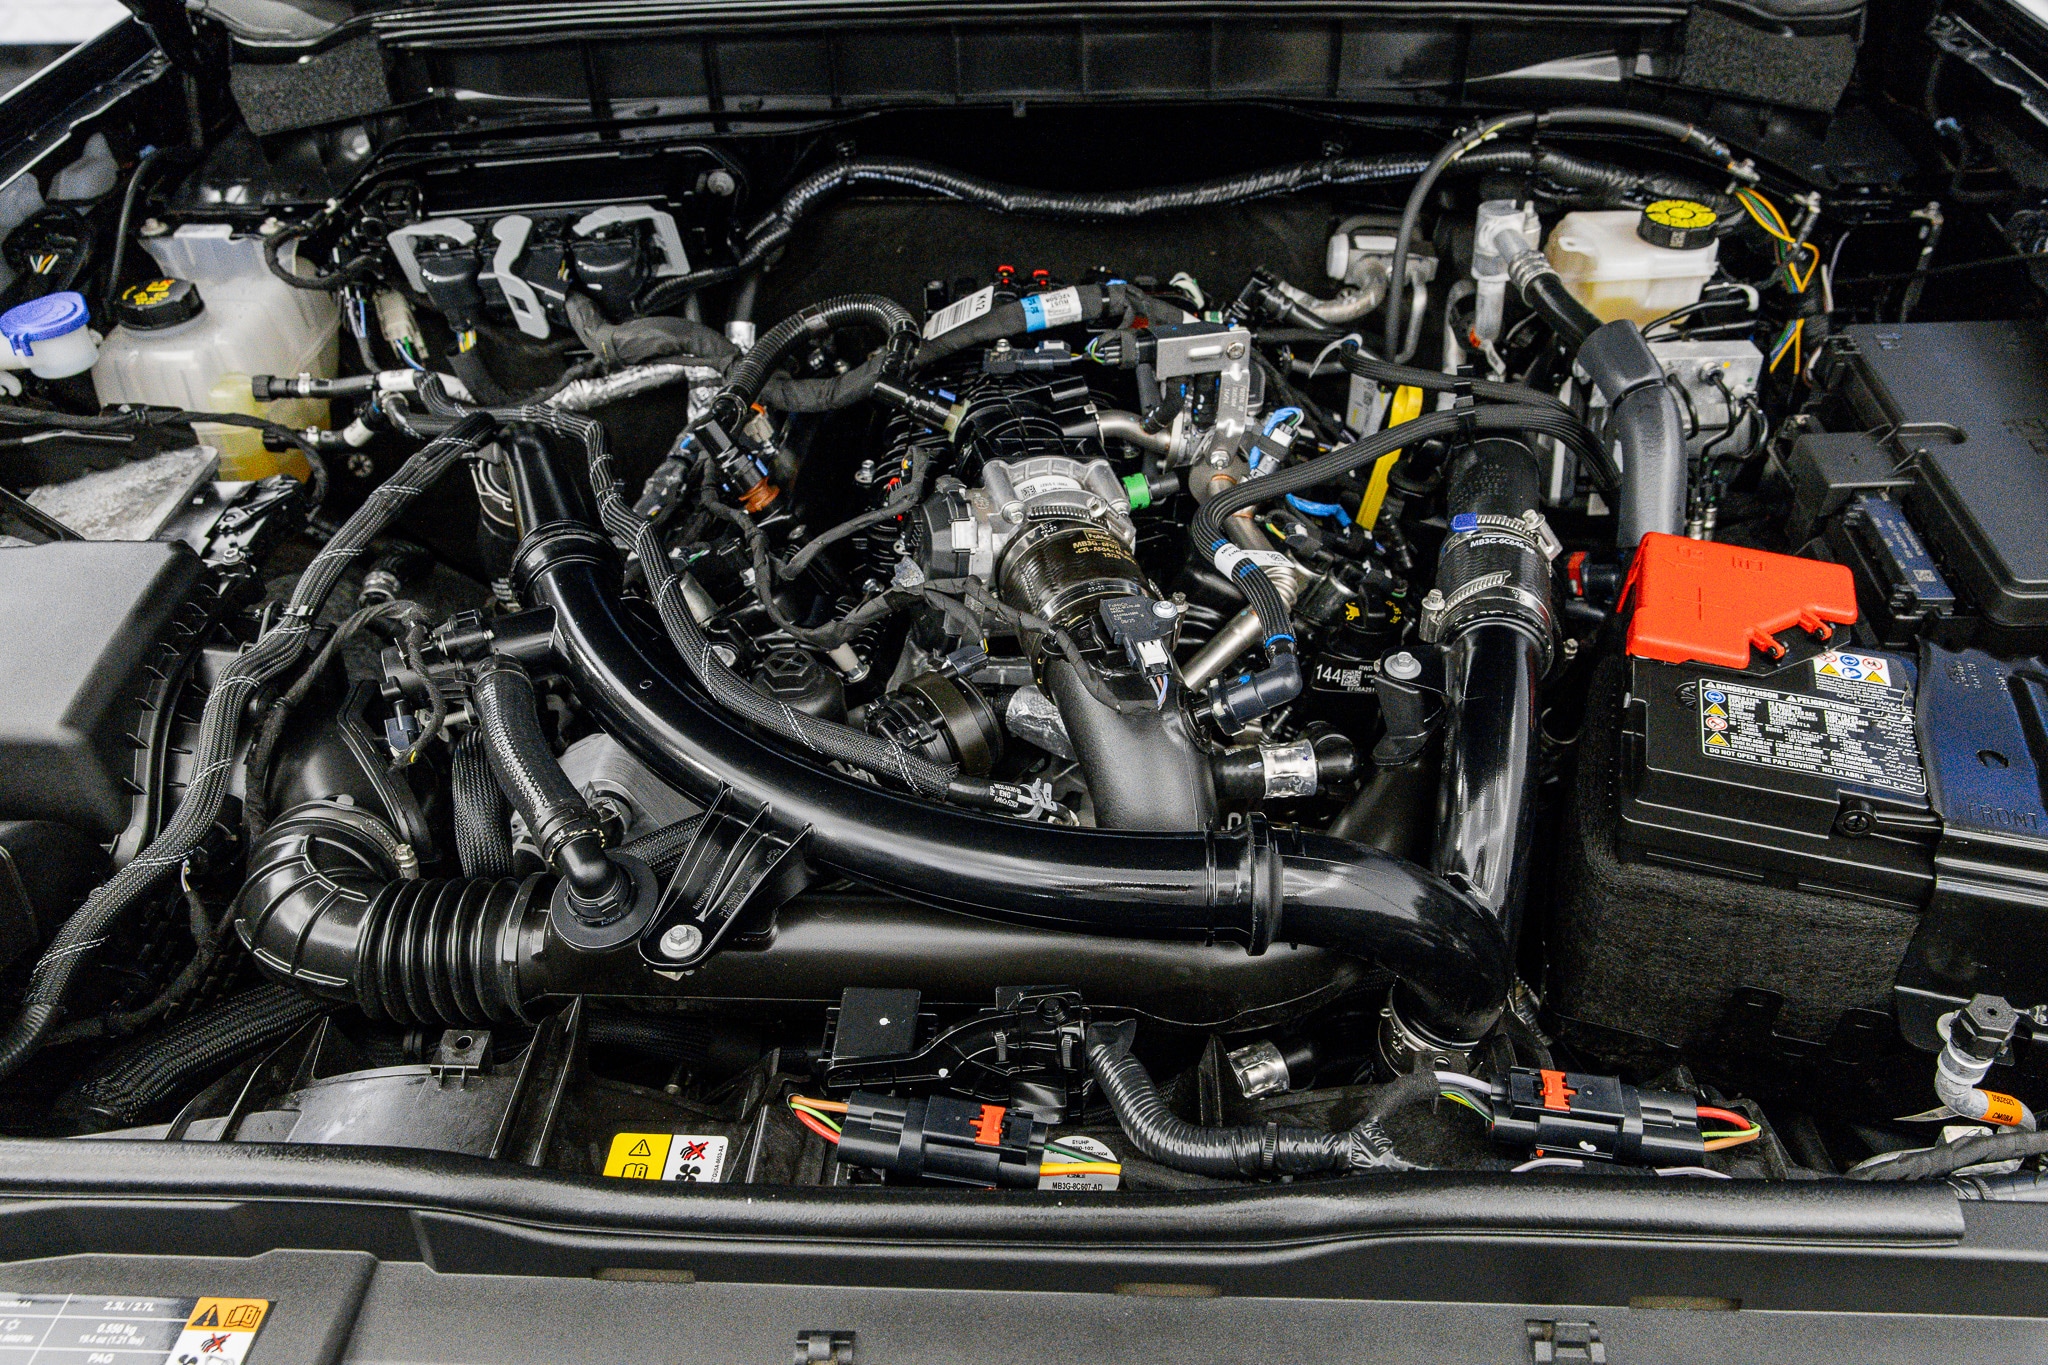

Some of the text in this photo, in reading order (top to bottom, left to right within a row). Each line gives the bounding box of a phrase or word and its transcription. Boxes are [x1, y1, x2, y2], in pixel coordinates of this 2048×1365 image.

[1316, 664, 1342, 683] 144
[1716, 683, 1779, 699] DANGER/POISON
[1797, 696, 1861, 714] PELIGRO/VENENO
[1721, 749, 1735, 757] NOT
[1737, 751, 1759, 761] OPEN.
[1762, 756, 1819, 771] NE PAS OUVRIR.
[1822, 766, 1868, 780] NO LA ABRA.
[1967, 803, 2039, 830] FRONT
[103, 1301, 126, 1311] 2.3L
[133, 1302, 155, 1312] 2.7L
[87, 1352, 115, 1364] PAG
